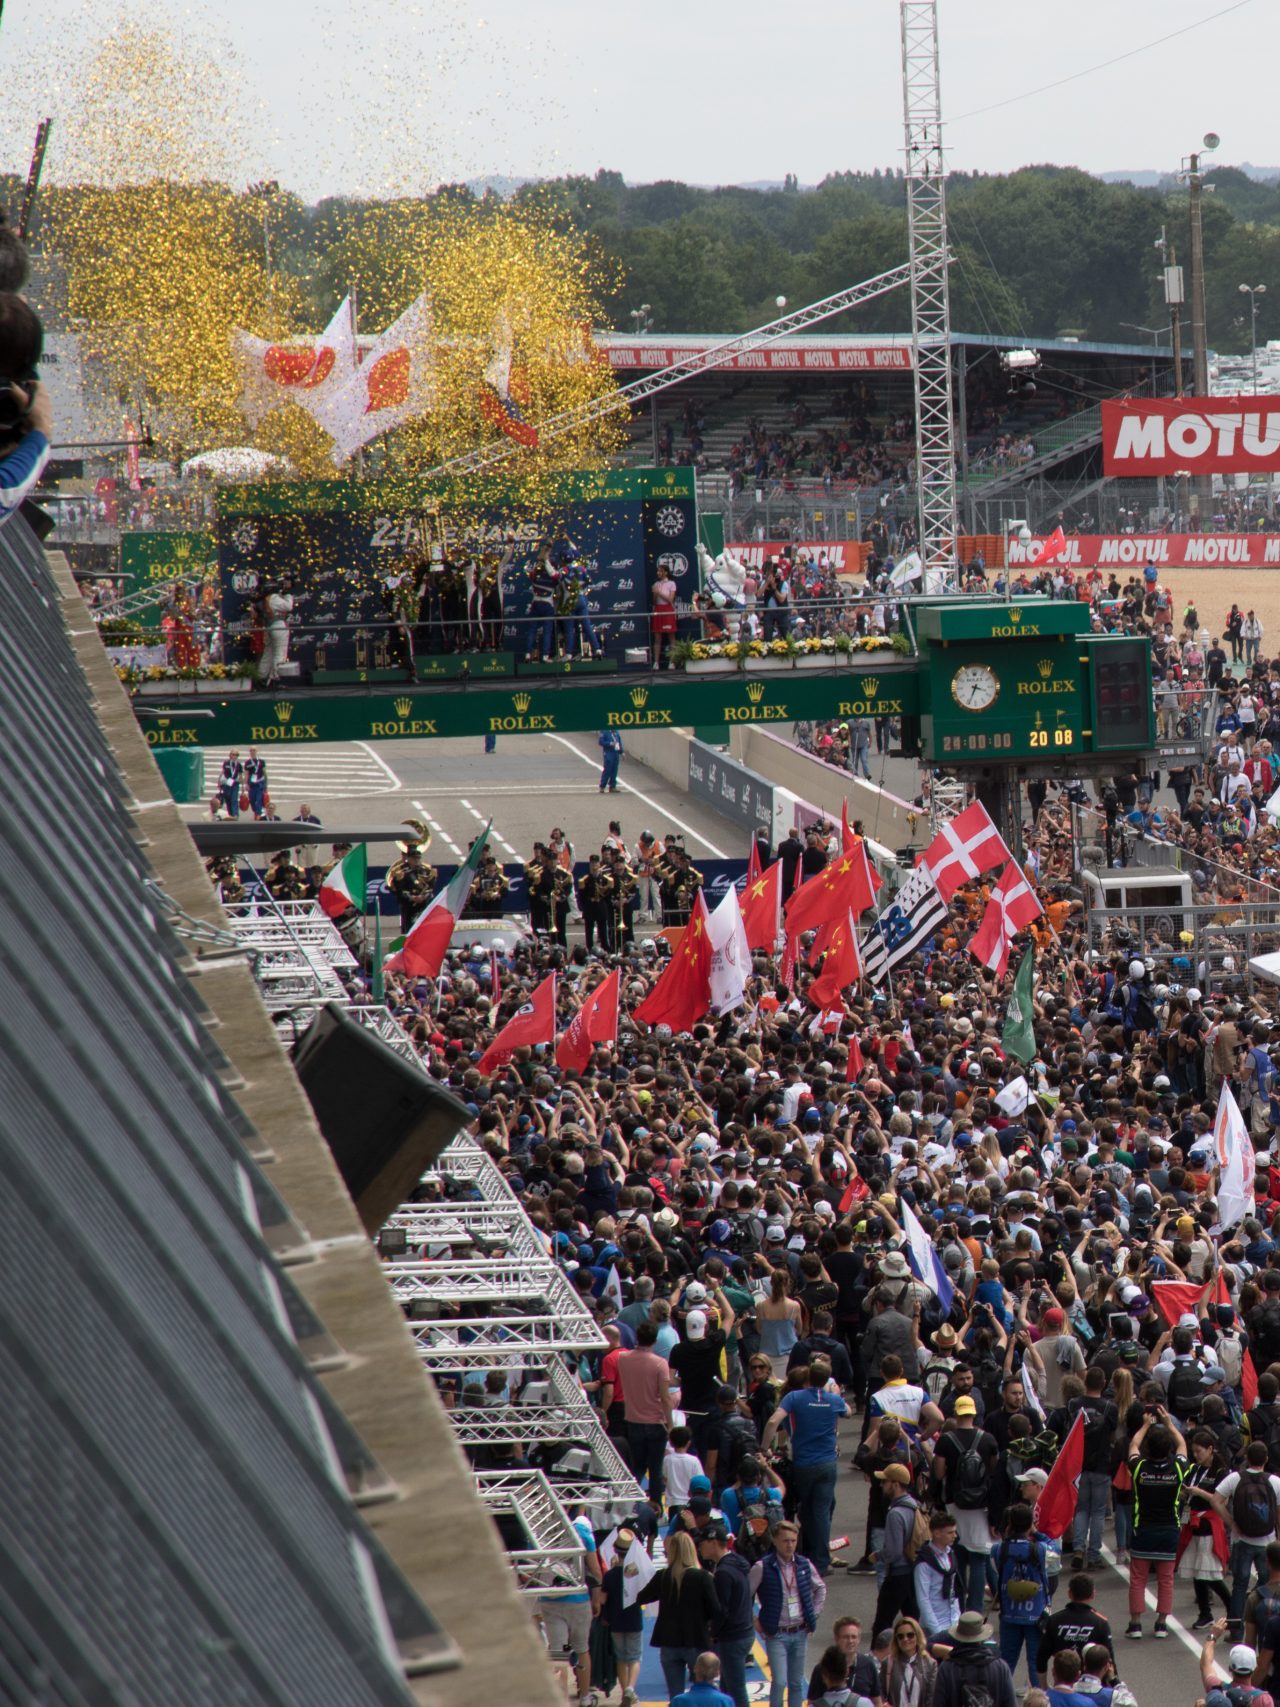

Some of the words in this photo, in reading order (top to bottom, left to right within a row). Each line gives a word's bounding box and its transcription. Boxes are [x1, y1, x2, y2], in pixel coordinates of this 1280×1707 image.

[609, 350, 638, 366] MOTUL
[640, 350, 669, 366] MOTUL
[738, 351, 767, 367] MOTUL
[771, 351, 800, 367] MOTUL
[805, 350, 835, 367] MOTUL
[839, 350, 869, 366] MOTUL
[874, 350, 905, 366] MOTUL
[581, 487, 624, 498] ROLEX
[652, 486, 689, 496] ROLEX
[1008, 540, 1082, 563] MOUL
[1099, 539, 1170, 562] MOTUL
[1184, 538, 1251, 562] MOTUL
[991, 624, 1041, 638] ROLEX
[564, 663, 571, 672] 3
[359, 672, 367, 681] 2
[1017, 680, 1076, 695] ROLEX
[145, 728, 198, 745] OLEX
[251, 724, 318, 741] ROLEX
[371, 720, 437, 736] ROLEX
[489, 714, 556, 731] ROLEX
[607, 709, 673, 726] ROLEX
[724, 704, 789, 721] ROLEX
[839, 699, 903, 716] ROLEX
[1029, 731, 1048, 748] 20
[1054, 729, 1073, 745] 08
[1058, 1624, 1095, 1637] TDS
